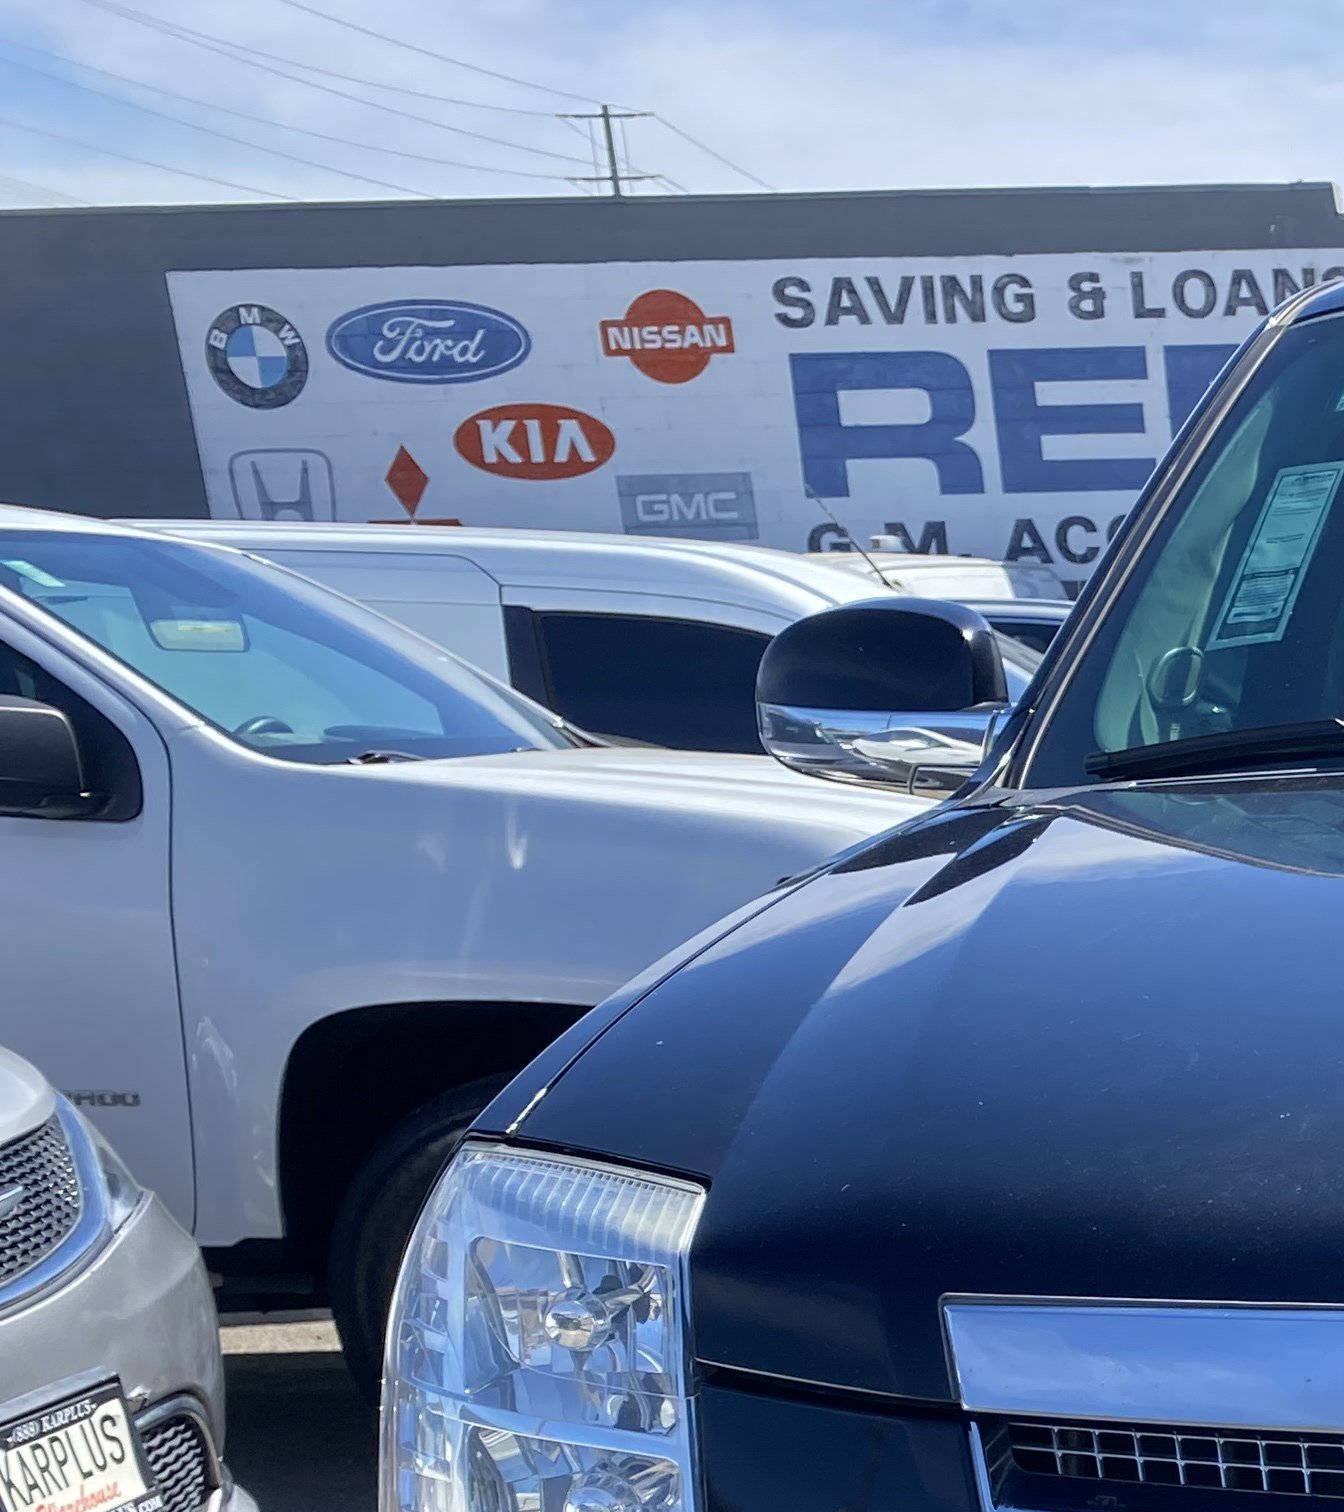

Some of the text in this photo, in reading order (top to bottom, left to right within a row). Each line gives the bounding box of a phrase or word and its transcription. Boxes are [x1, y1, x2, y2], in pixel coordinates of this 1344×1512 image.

[772, 271, 1037, 329] SAVING
[1068, 271, 1107, 322] &
[373, 315, 486, 365] Ford
[607, 324, 728, 350] NISSAN
[476, 418, 598, 465] KIA
[635, 491, 740, 523] GMC
[0, 1414, 126, 1512] KARPLUS
